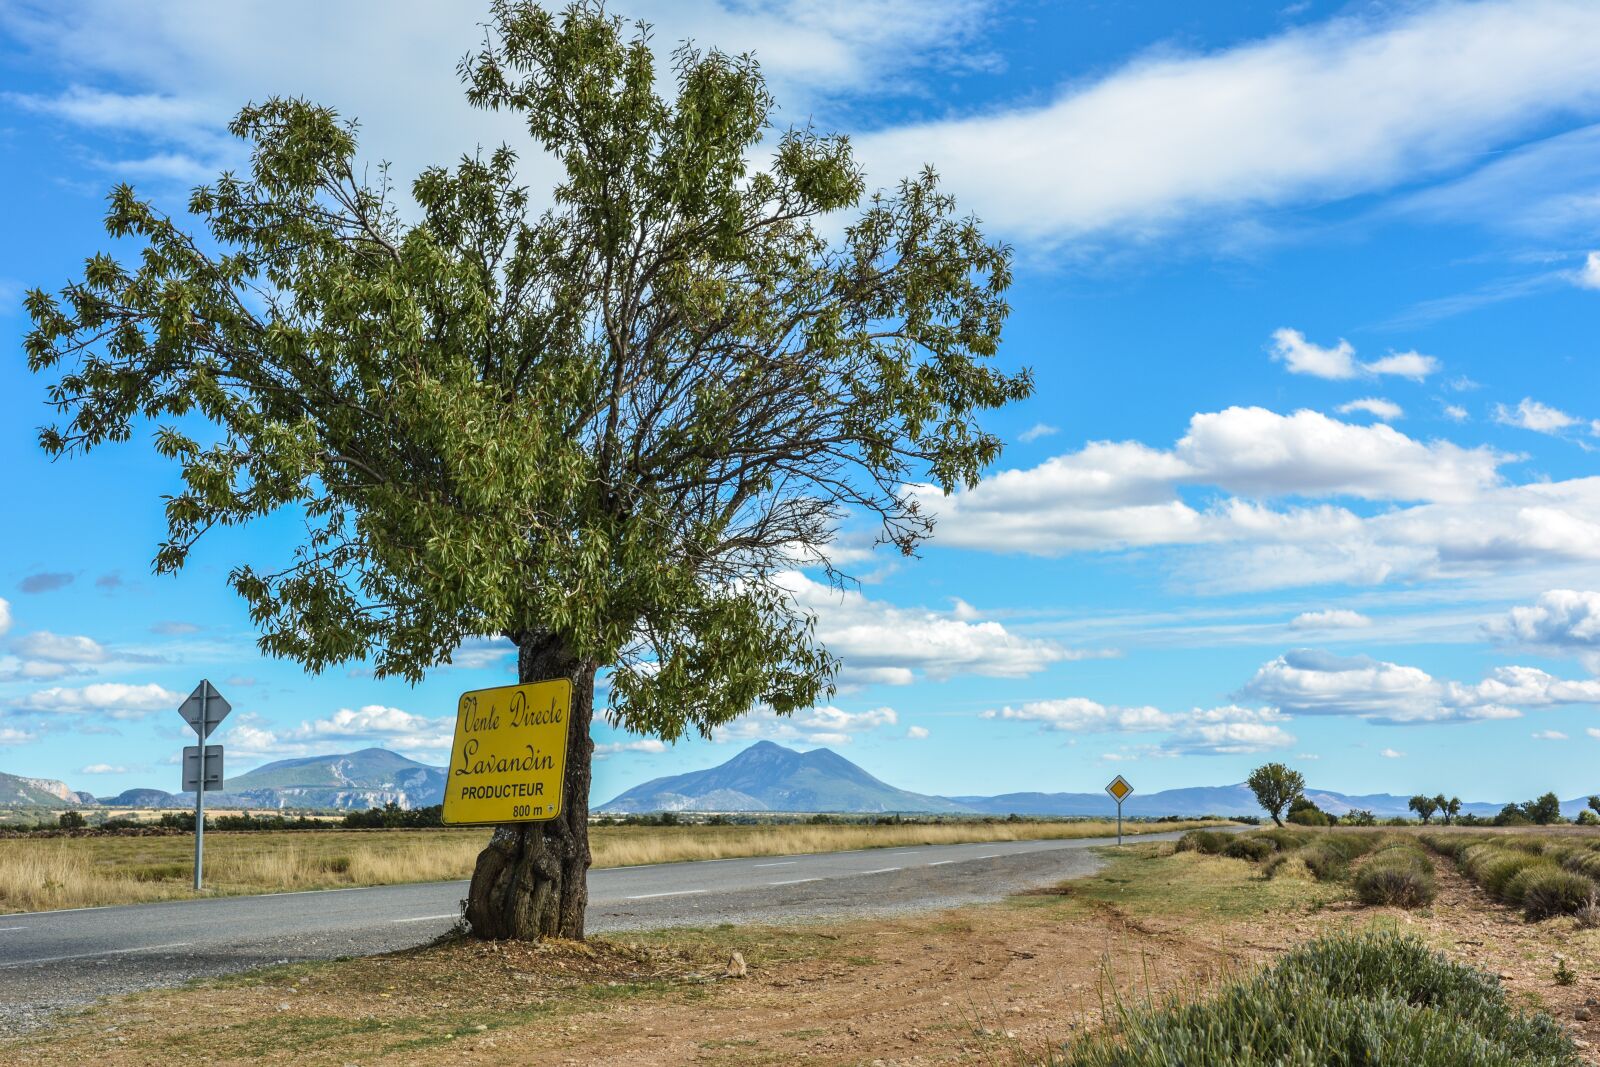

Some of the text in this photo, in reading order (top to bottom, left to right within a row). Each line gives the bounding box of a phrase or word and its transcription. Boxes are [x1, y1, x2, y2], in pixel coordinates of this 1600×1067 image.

[463, 690, 563, 733] Vente Directe
[455, 738, 555, 776] Lavandin
[461, 782, 544, 800] PRODUCTEUR
[513, 805, 543, 818] 800 m
